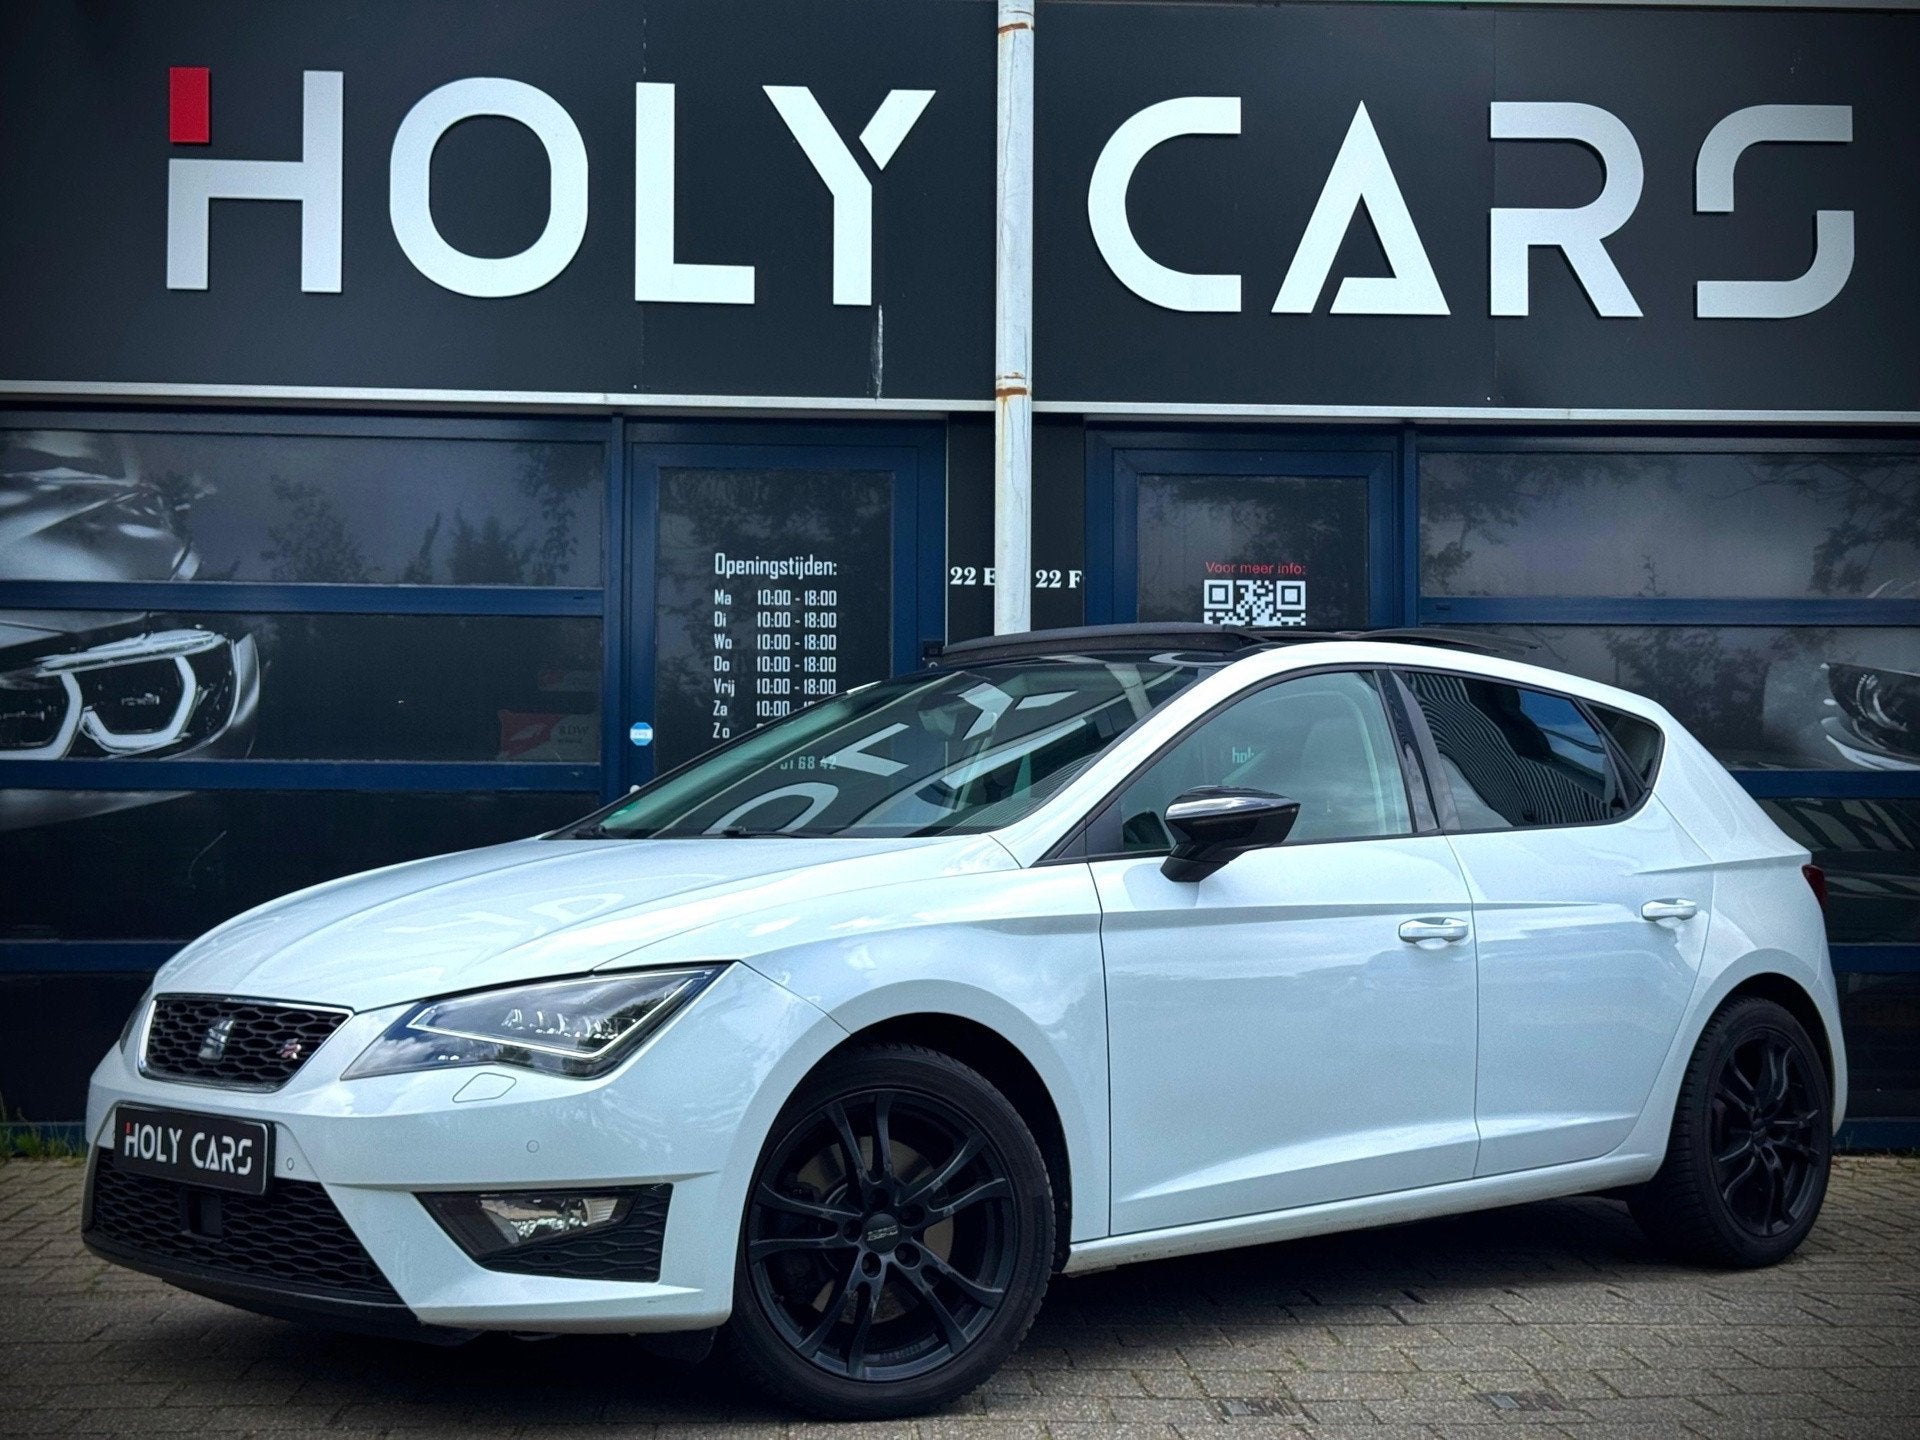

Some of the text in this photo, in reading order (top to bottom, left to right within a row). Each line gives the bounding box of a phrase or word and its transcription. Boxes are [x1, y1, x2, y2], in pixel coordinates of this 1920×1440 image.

[166, 66, 1855, 319] HOLY CARS
[714, 552, 838, 580] Openingstijden:
[1205, 561, 1306, 576] Voor meer info:
[949, 566, 995, 586] 22 E
[1035, 569, 1083, 588] 22 F
[713, 588, 732, 606] Ma
[757, 589, 791, 606] 10:00
[804, 589, 837, 606] 18:00
[713, 610, 727, 628] Di
[757, 611, 791, 628] 10:00
[804, 612, 837, 628] 18:00
[713, 633, 733, 650] Wo
[757, 633, 791, 650] 10:00
[804, 634, 837, 650] 18:00
[713, 655, 731, 672] Do
[757, 656, 791, 672] 10:00
[804, 656, 837, 672] 18:00
[713, 677, 735, 698] Vrij
[757, 678, 791, 694] 10:00
[803, 679, 837, 695] 18:00
[713, 699, 791, 717] Za 10:00
[712, 722, 731, 739] Zo
[1232, 746, 1254, 763] hol
[124, 1122, 252, 1175] HOLY CARS
